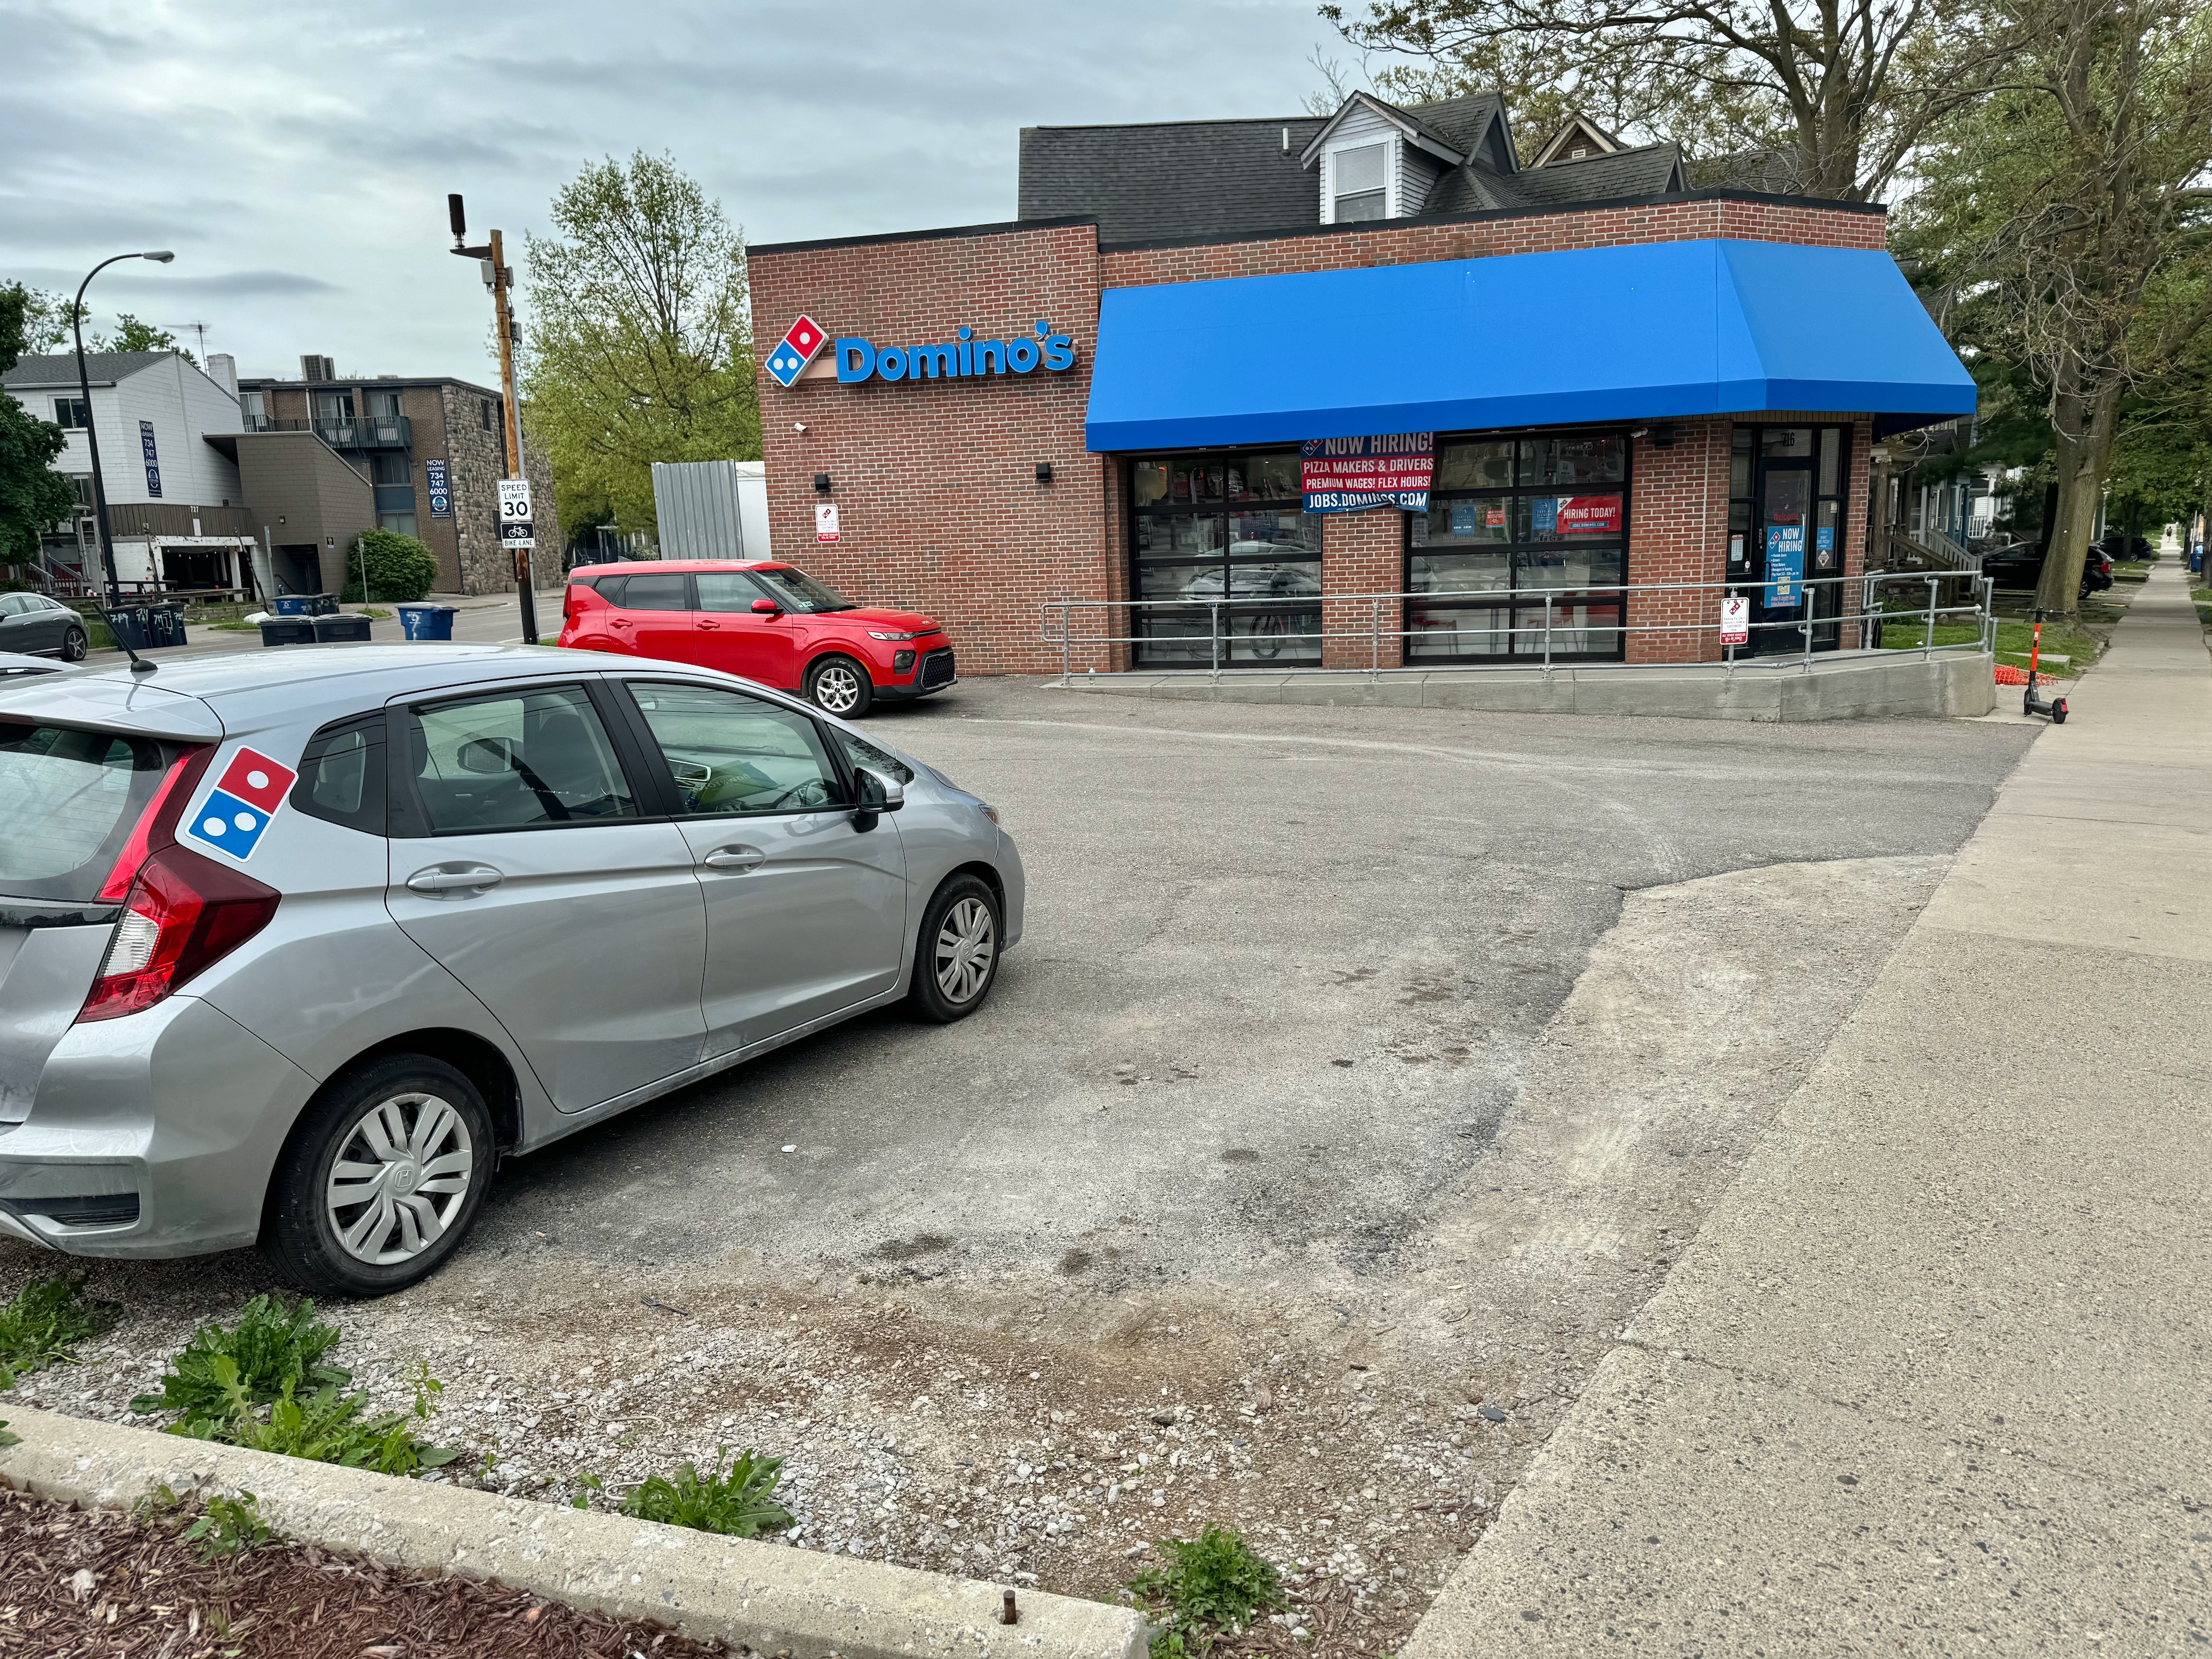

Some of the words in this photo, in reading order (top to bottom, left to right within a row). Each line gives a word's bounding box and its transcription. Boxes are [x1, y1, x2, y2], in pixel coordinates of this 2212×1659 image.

[835, 320, 1076, 383] Domino's
[140, 422, 152, 430] NOW
[144, 439, 153, 447] 734
[1325, 436, 1364, 455] NOW
[1371, 432, 1433, 453] HIRING!
[1780, 432, 1795, 447] 716
[145, 449, 154, 457] 747
[145, 458, 157, 467] 6000
[1304, 461, 1330, 474] PIZZA
[1333, 460, 1375, 473] MAKERS
[1378, 459, 1386, 472] &
[1390, 458, 1434, 472] DRIVERS
[1306, 477, 1343, 489] PREMIUM
[1345, 477, 1375, 489] WAGES!
[1378, 477, 1398, 488] FLEX
[1401, 475, 1431, 487] HOURS!
[1309, 492, 1427, 509] JOBS.DOMINOS.COM
[504, 501, 528, 516] 30
[1564, 508, 1589, 519] HIRING
[1591, 507, 1615, 518] TODAY!
[1773, 513, 1799, 521] Welcome
[1782, 528, 1799, 540] NOW
[1778, 540, 1802, 552] HIRING
